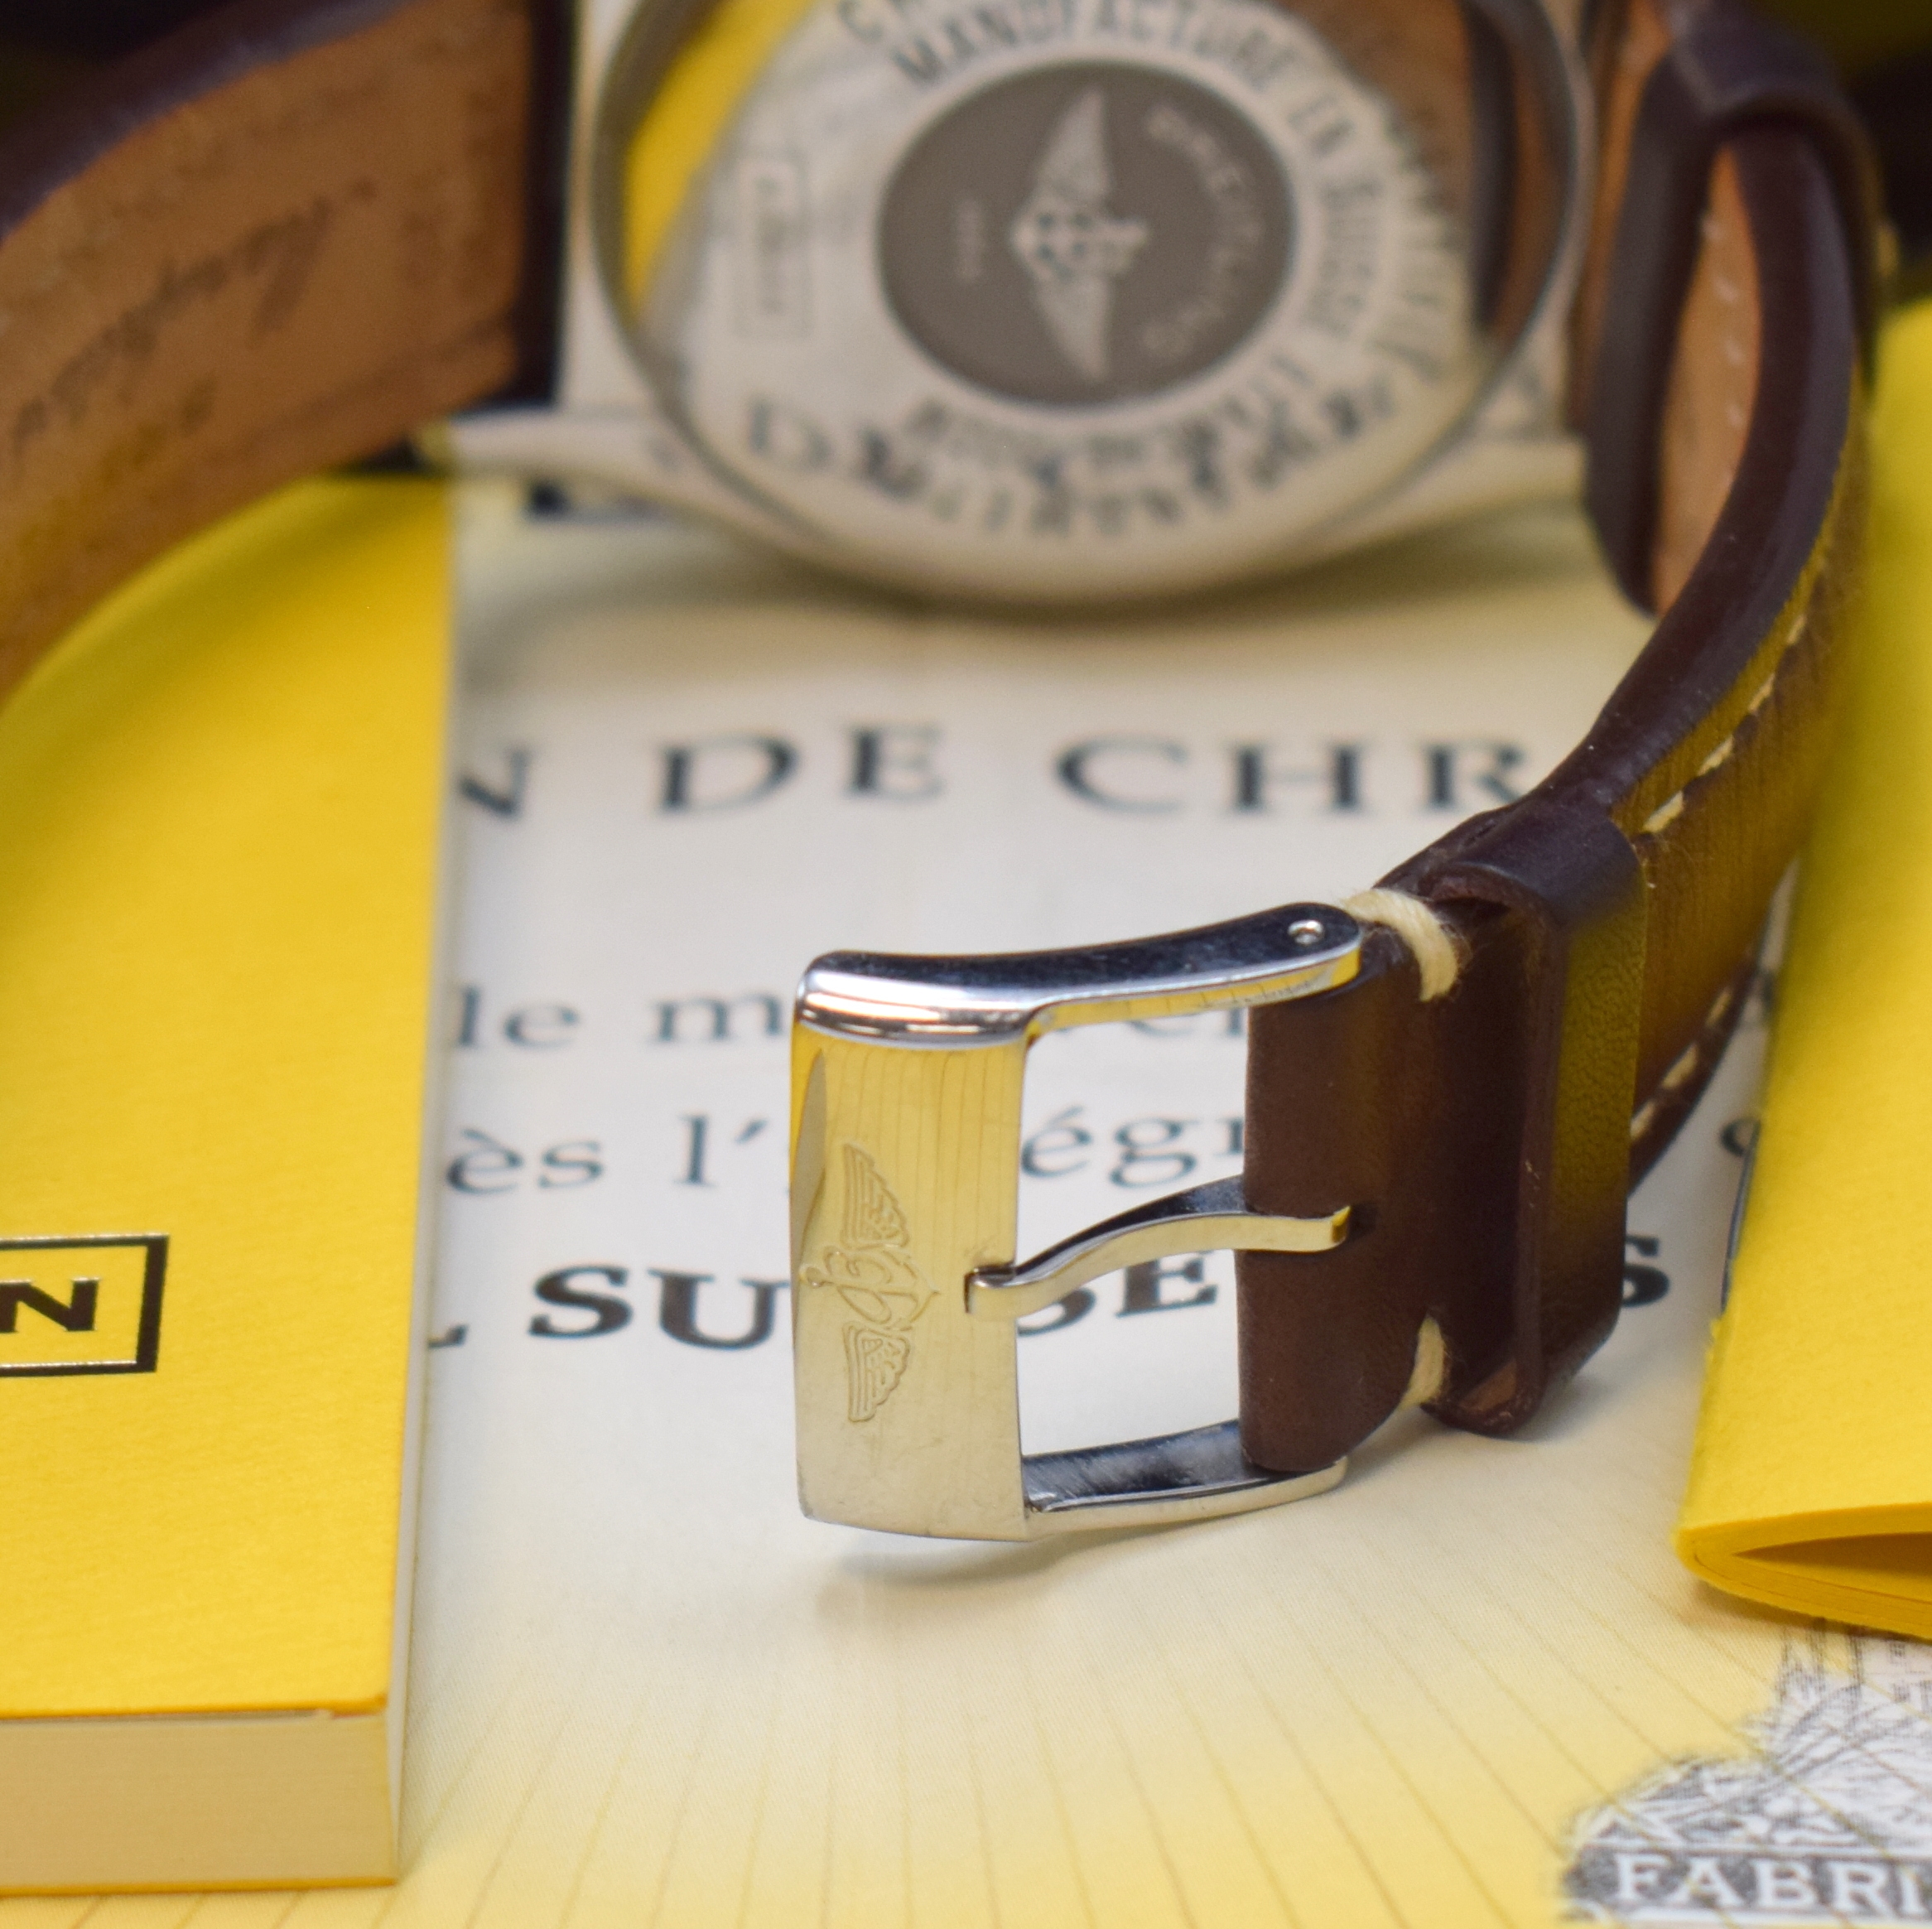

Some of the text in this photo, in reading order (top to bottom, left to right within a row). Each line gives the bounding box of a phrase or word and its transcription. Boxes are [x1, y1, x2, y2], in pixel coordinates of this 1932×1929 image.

[656, 726, 947, 817] DE
[455, 986, 583, 1052] le
[1613, 1852, 1932, 1920] FABRI
